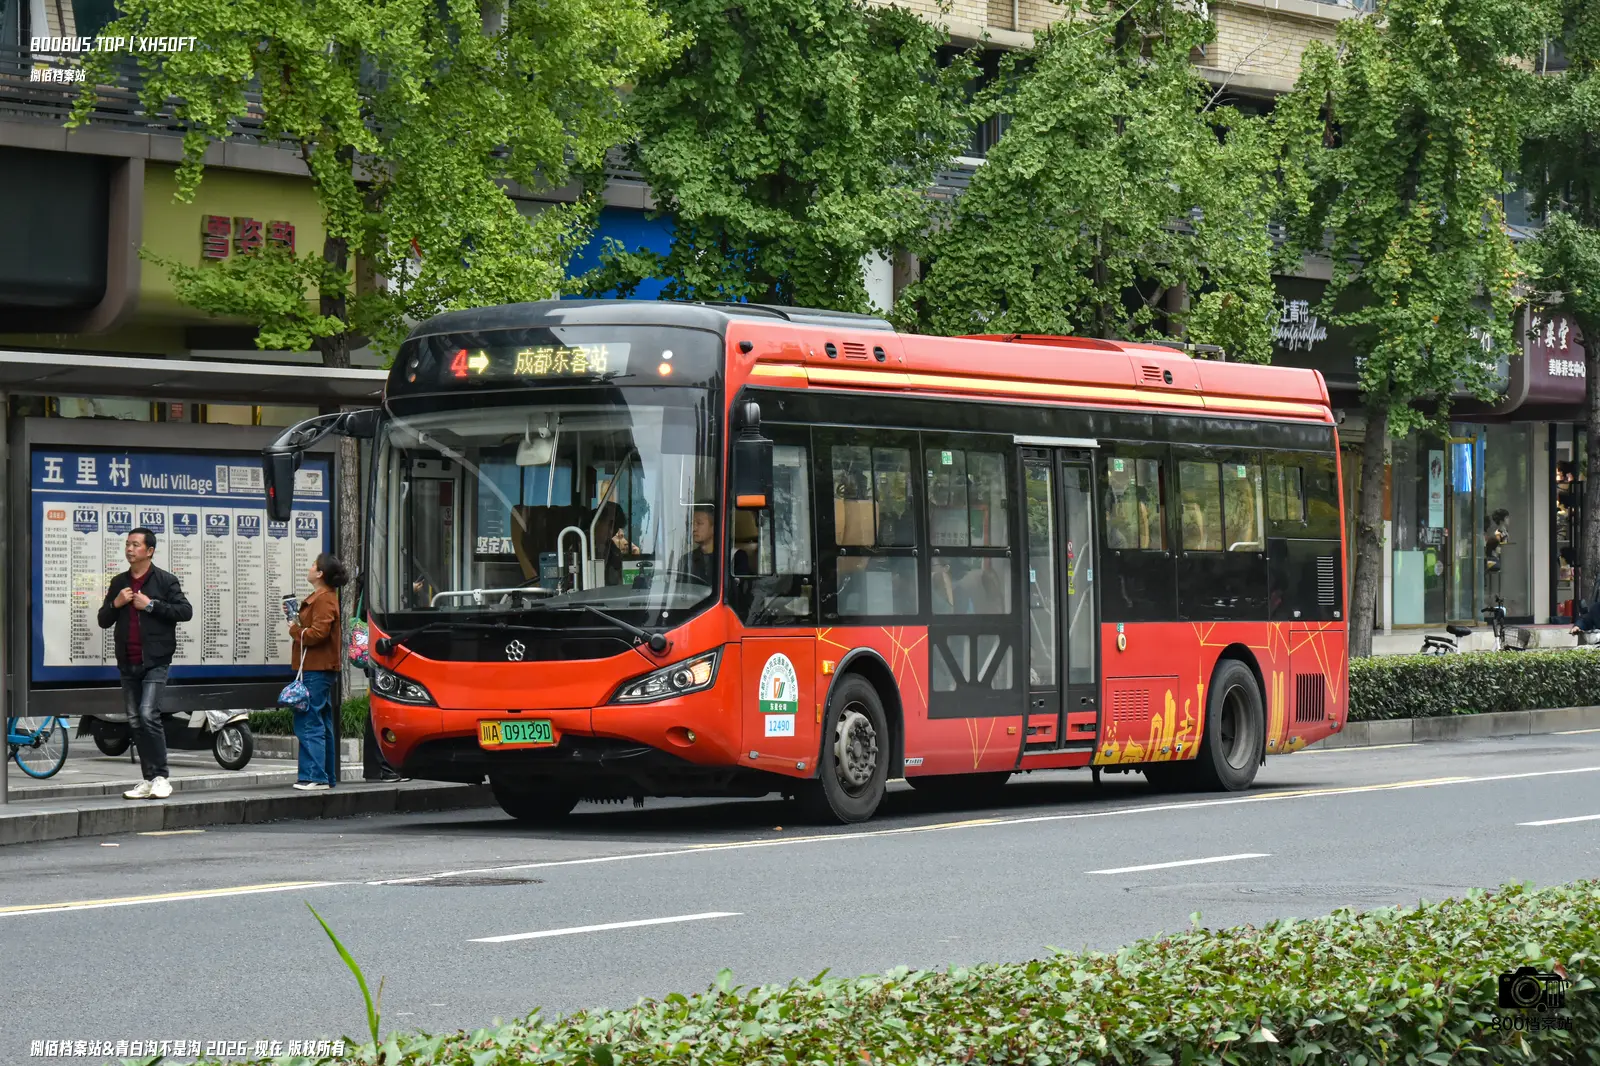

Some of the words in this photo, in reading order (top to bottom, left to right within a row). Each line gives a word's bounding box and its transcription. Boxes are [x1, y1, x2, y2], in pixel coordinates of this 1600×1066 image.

[451, 349, 468, 377] 4
[514, 346, 609, 375] 成都东客站
[42, 457, 131, 487] 五里村
[140, 473, 168, 490] Wuli
[170, 474, 213, 495] Village
[75, 511, 96, 522] K12
[109, 512, 129, 523] K17
[142, 512, 162, 524] K18
[181, 514, 190, 525] 4
[209, 515, 226, 526] 62
[239, 516, 257, 527] 107
[298, 518, 316, 529] 214
[476, 536, 515, 554] 坚定不
[769, 720, 790, 732] 12490
